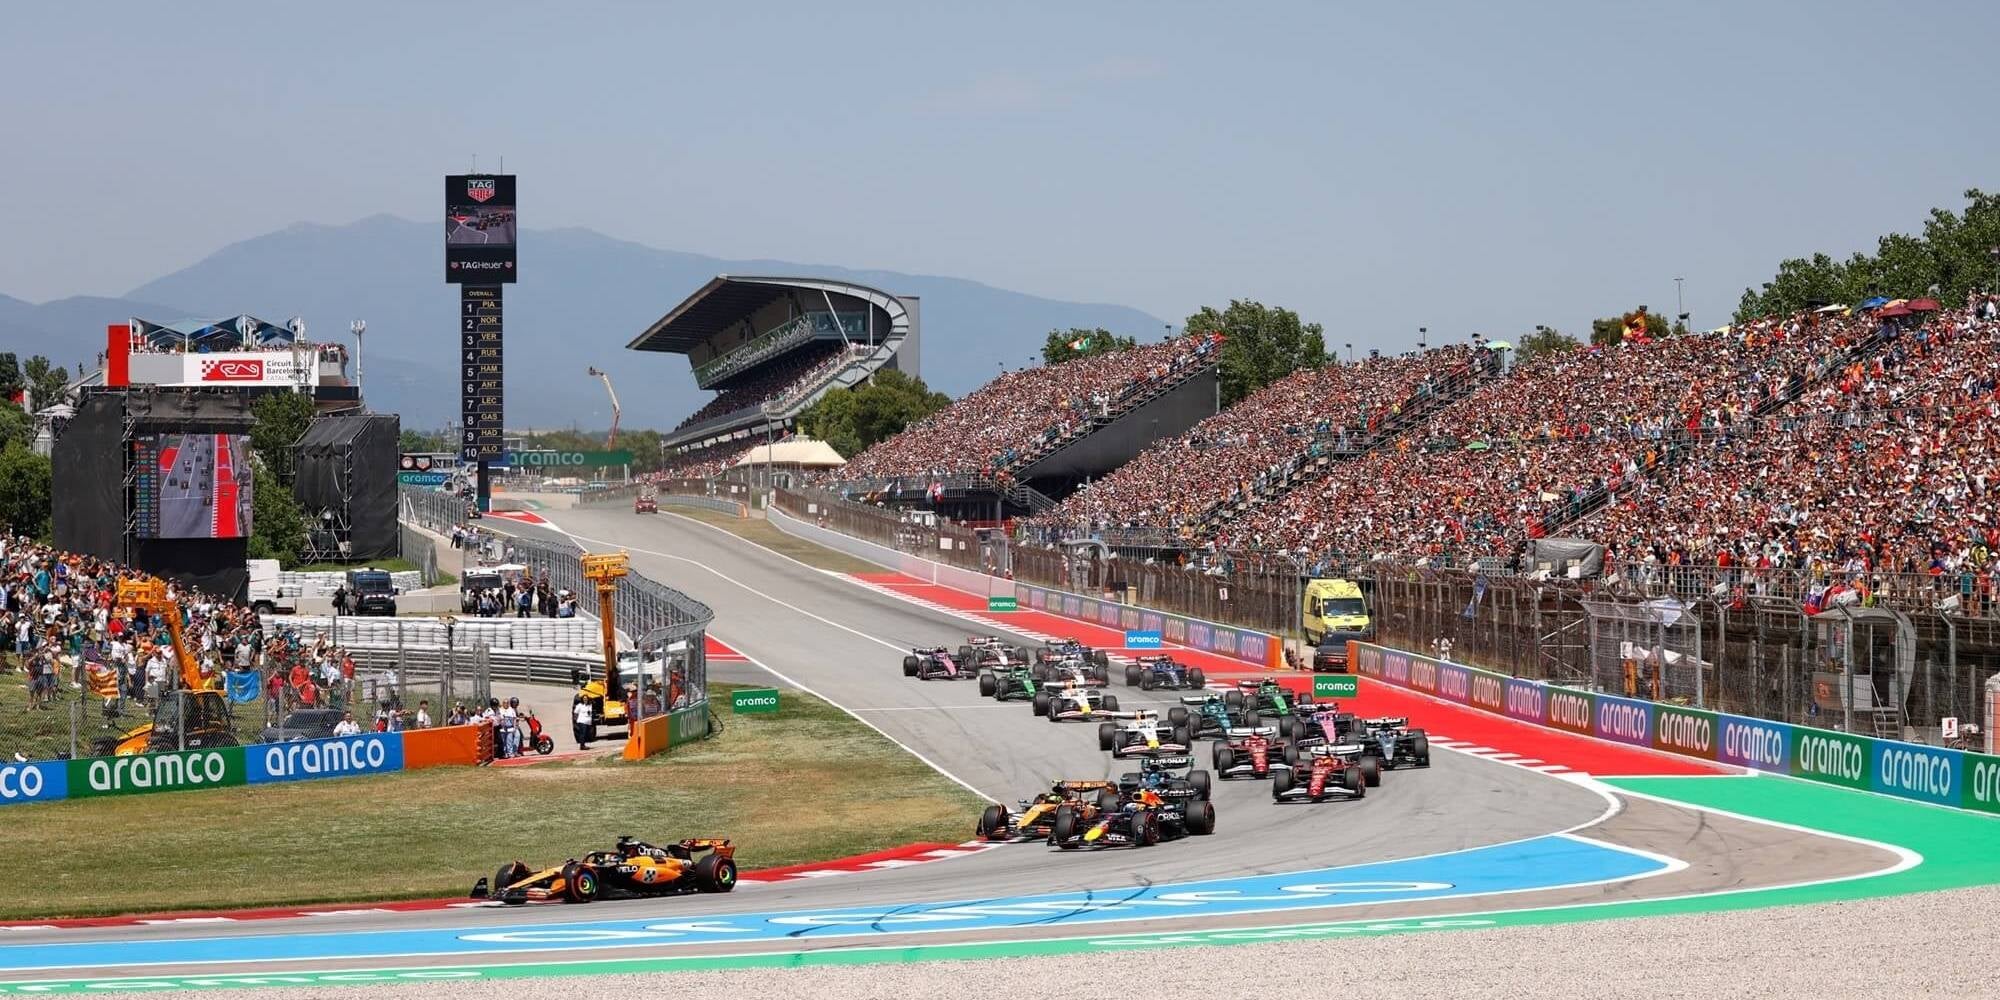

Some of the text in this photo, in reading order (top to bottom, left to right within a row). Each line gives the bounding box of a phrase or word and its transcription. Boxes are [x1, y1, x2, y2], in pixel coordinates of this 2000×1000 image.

[467, 304, 472, 313] 1
[467, 320, 473, 329] 2
[467, 336, 473, 345] 3
[467, 352, 474, 361] 4
[467, 368, 474, 377] 5
[467, 384, 474, 393] 6
[467, 400, 474, 409] 7
[467, 416, 474, 425] 8
[467, 432, 474, 441] 9
[464, 448, 477, 457] 10
[509, 452, 585, 465] aramco
[1128, 636, 1160, 644] aramco
[1385, 654, 1407, 681] aramco
[1411, 661, 1436, 690] aramco
[1316, 682, 1356, 691] aramco
[1441, 668, 1467, 699] aramco
[1473, 675, 1501, 708] aramco
[735, 696, 777, 707] aramco
[1508, 679, 1541, 719] aramco
[1551, 690, 1589, 730] aramco
[1600, 698, 1647, 740] aramco
[1659, 711, 1711, 753] aramco
[1725, 722, 1783, 767] aramco
[265, 738, 385, 776] aramco
[1800, 734, 1862, 781] aramco
[89, 751, 225, 791] aramco
[1881, 748, 1951, 797] aramco
[617, 865, 638, 873] VELO
[457, 881, 1456, 942] aramco
[0, 971, 482, 991] ramco
